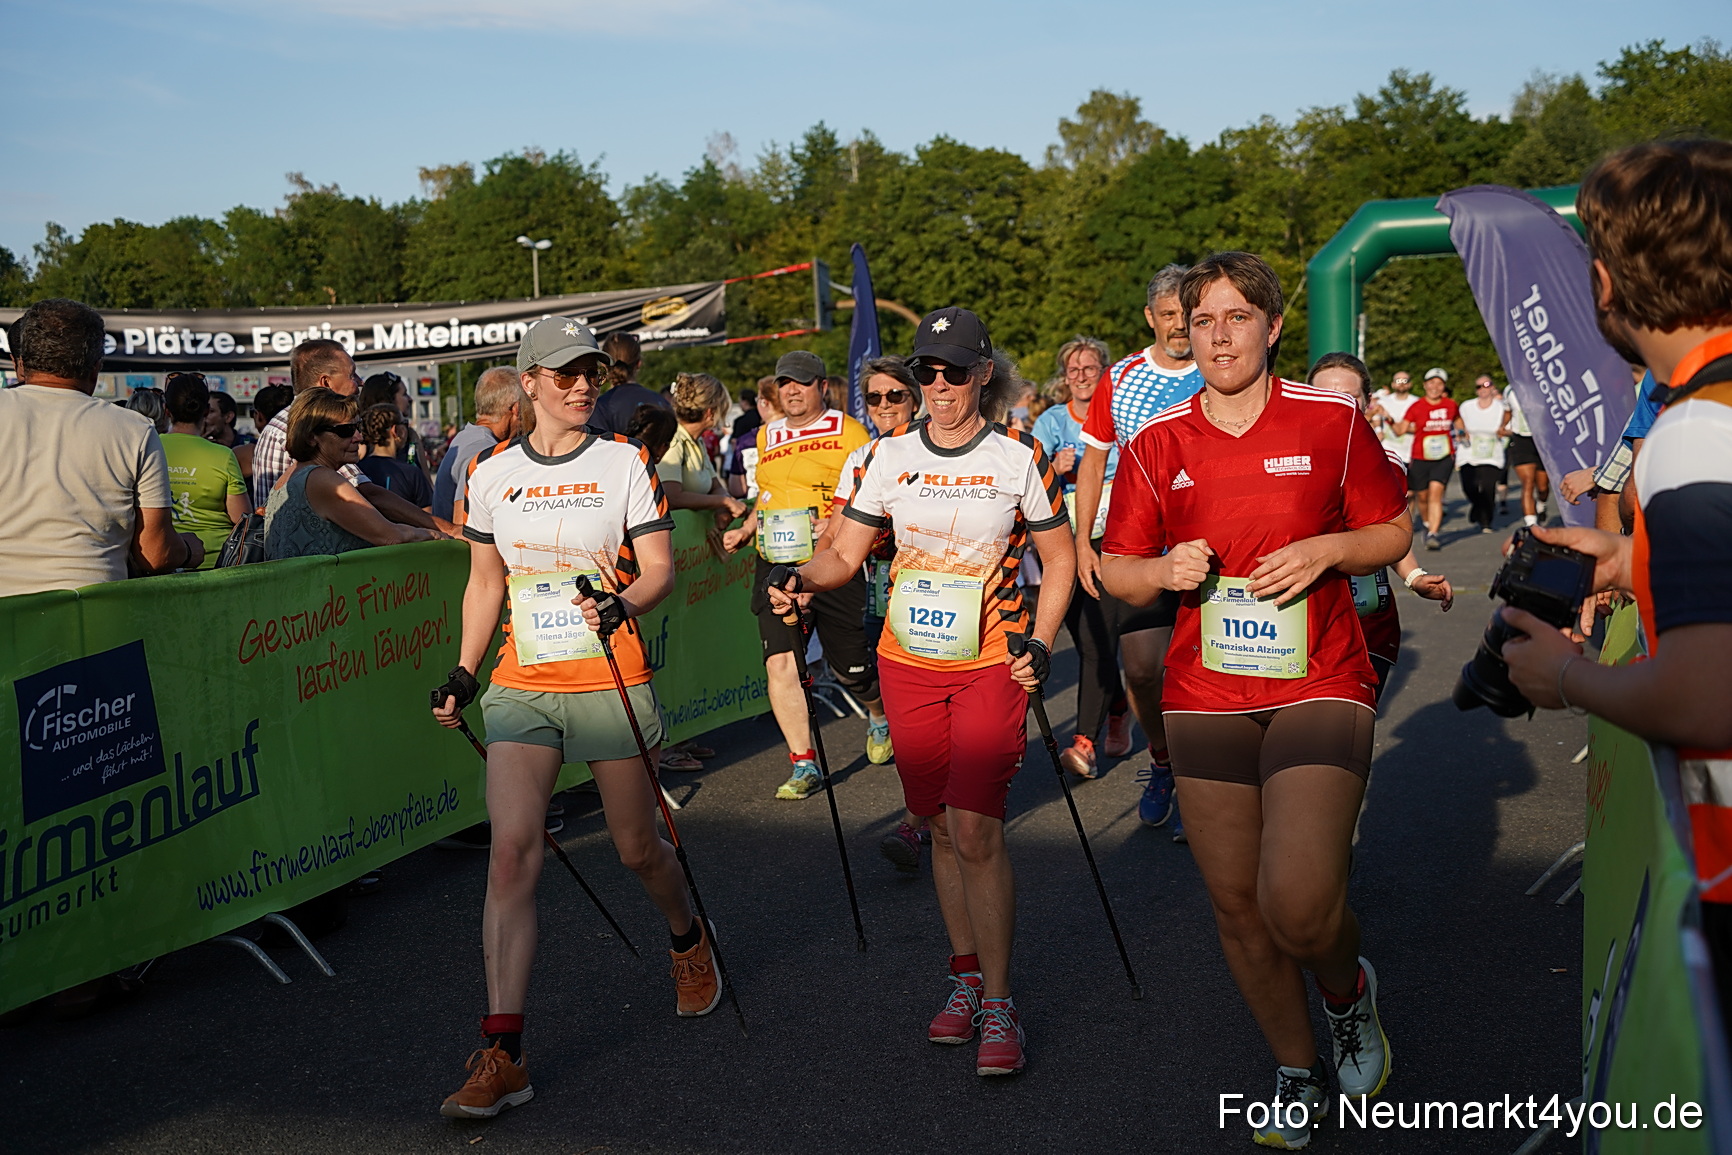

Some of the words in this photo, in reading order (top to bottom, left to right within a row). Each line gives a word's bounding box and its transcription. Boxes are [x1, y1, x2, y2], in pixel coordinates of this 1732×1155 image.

[124, 325, 246, 355] Plätze.
[372, 314, 597, 350] Miteinan.
[760, 446, 793, 465] MAX
[798, 440, 843, 453] BÖGL
[1263, 455, 1311, 468] HUBER
[167, 466, 189, 474] RATA
[923, 473, 999, 487] KLEBL
[526, 482, 605, 498] KLEBL
[919, 486, 999, 500] DYNAMICS
[1171, 480, 1195, 490] adidas
[522, 496, 605, 513] DYNAMICS
[772, 531, 796, 542] 1712
[238, 585, 350, 664] Gesunde
[356, 571, 431, 627] Firmen
[531, 608, 584, 630] 1286
[908, 606, 957, 629] 1287
[1222, 617, 1278, 641] 1104
[536, 633, 562, 641] Milena
[564, 630, 586, 640] Jäger
[908, 628, 936, 639] Sandra
[937, 631, 958, 642] Jäger
[295, 641, 369, 703] laufen
[375, 600, 452, 670] länger!
[1210, 638, 1255, 652] Franziska
[1256, 645, 1297, 657] Alzinger
[42, 692, 136, 741] Fischer
[52, 717, 132, 753] AUTOMOBILE
[72, 756, 94, 777] und
[95, 749, 115, 765] das
[101, 761, 129, 785] fährt
[130, 745, 153, 765] mit!
[0, 718, 260, 902] irmenlauf
[197, 779, 460, 911] www.firmenlauf-oberpfalz.de
[0, 866, 119, 942] umarkt
